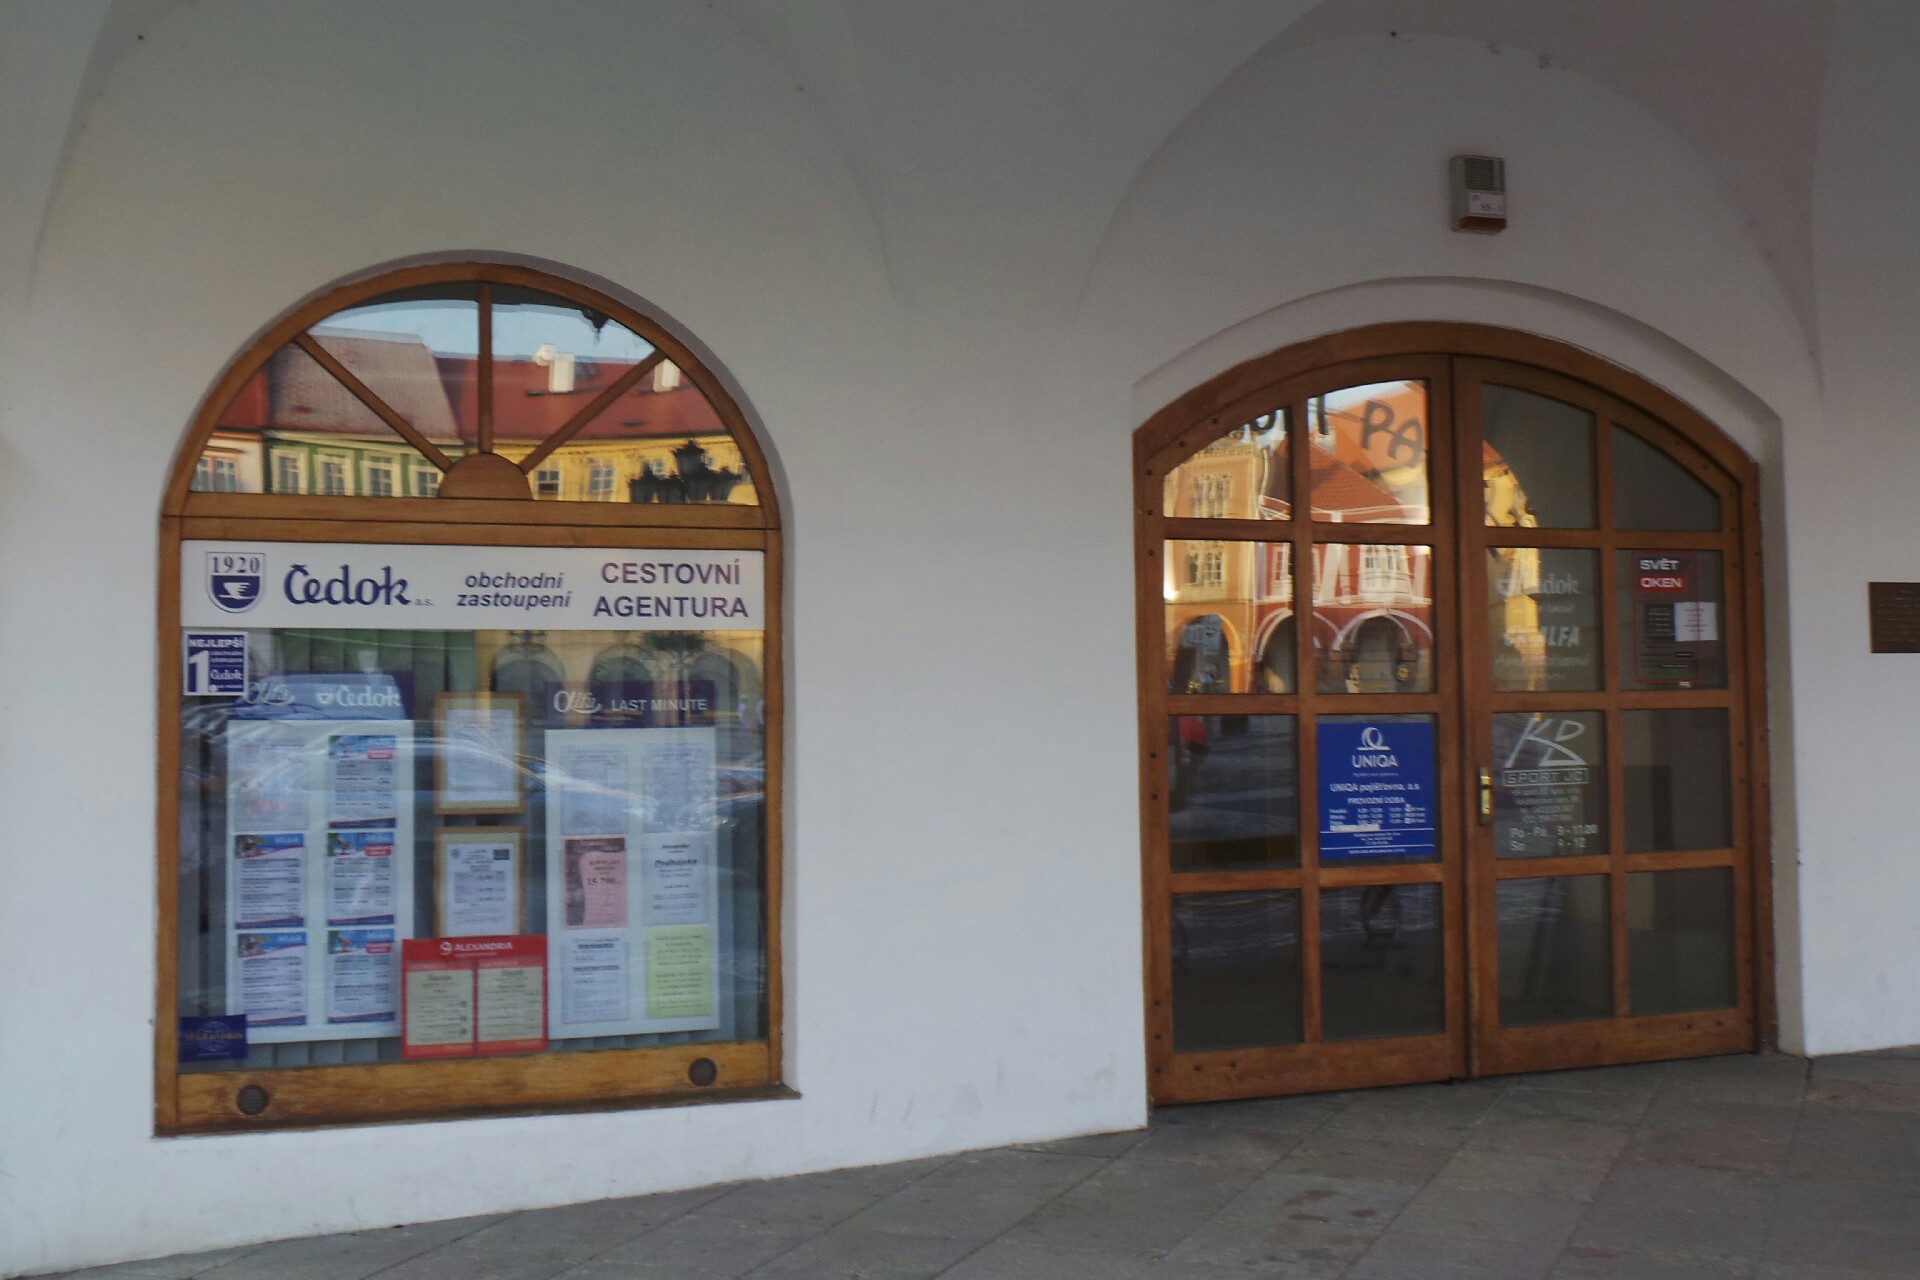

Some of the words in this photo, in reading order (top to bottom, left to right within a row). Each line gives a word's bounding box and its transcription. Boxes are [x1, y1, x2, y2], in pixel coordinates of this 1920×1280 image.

[212, 556, 261, 574] 1920
[601, 559, 740, 585] CESTOVNÍ
[1639, 557, 1679, 571] SVĚT
[284, 564, 410, 606] Čedok
[465, 572, 564, 589] obchodní
[1640, 577, 1683, 588] OKEN
[457, 591, 572, 611] zastoupení
[593, 596, 749, 618] AGENTURA
[611, 699, 648, 711] LAST
[651, 699, 708, 711] MINUTE
[1351, 754, 1398, 769] UNIQA
